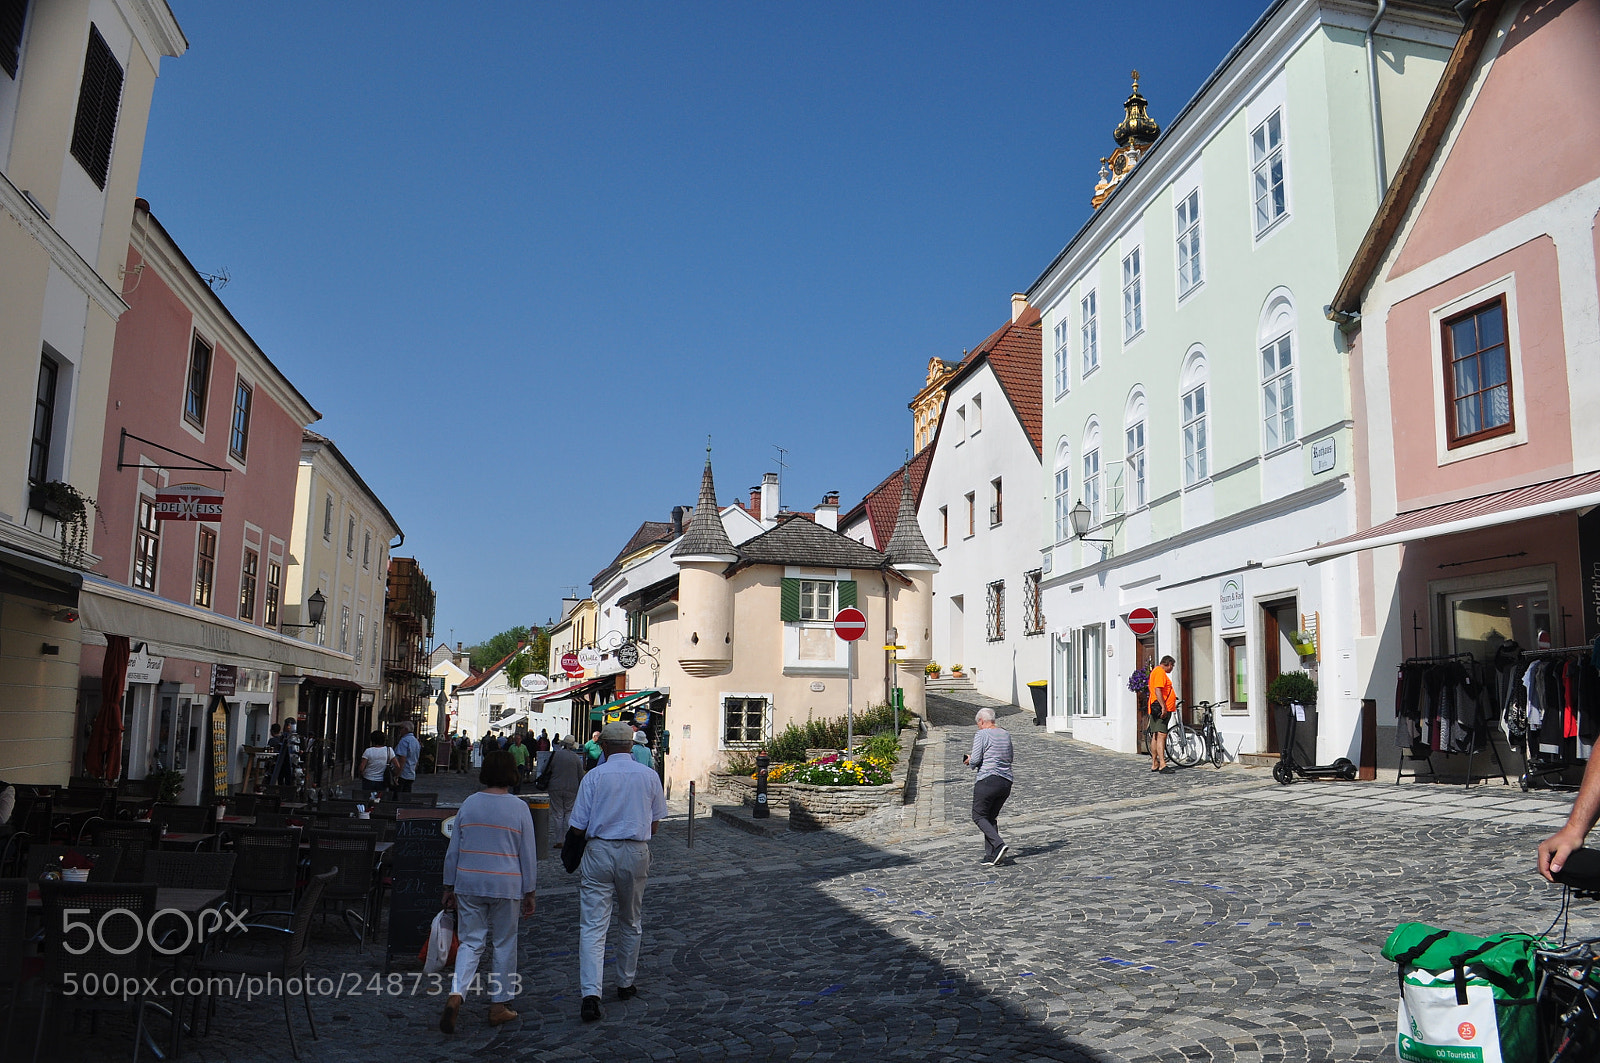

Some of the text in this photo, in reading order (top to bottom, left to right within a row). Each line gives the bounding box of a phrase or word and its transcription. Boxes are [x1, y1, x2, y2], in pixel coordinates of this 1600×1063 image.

[155, 502, 223, 514] EDELWEISS
[146, 658, 162, 670] Brandl
[1446, 1049, 1476, 1059] Touristik
